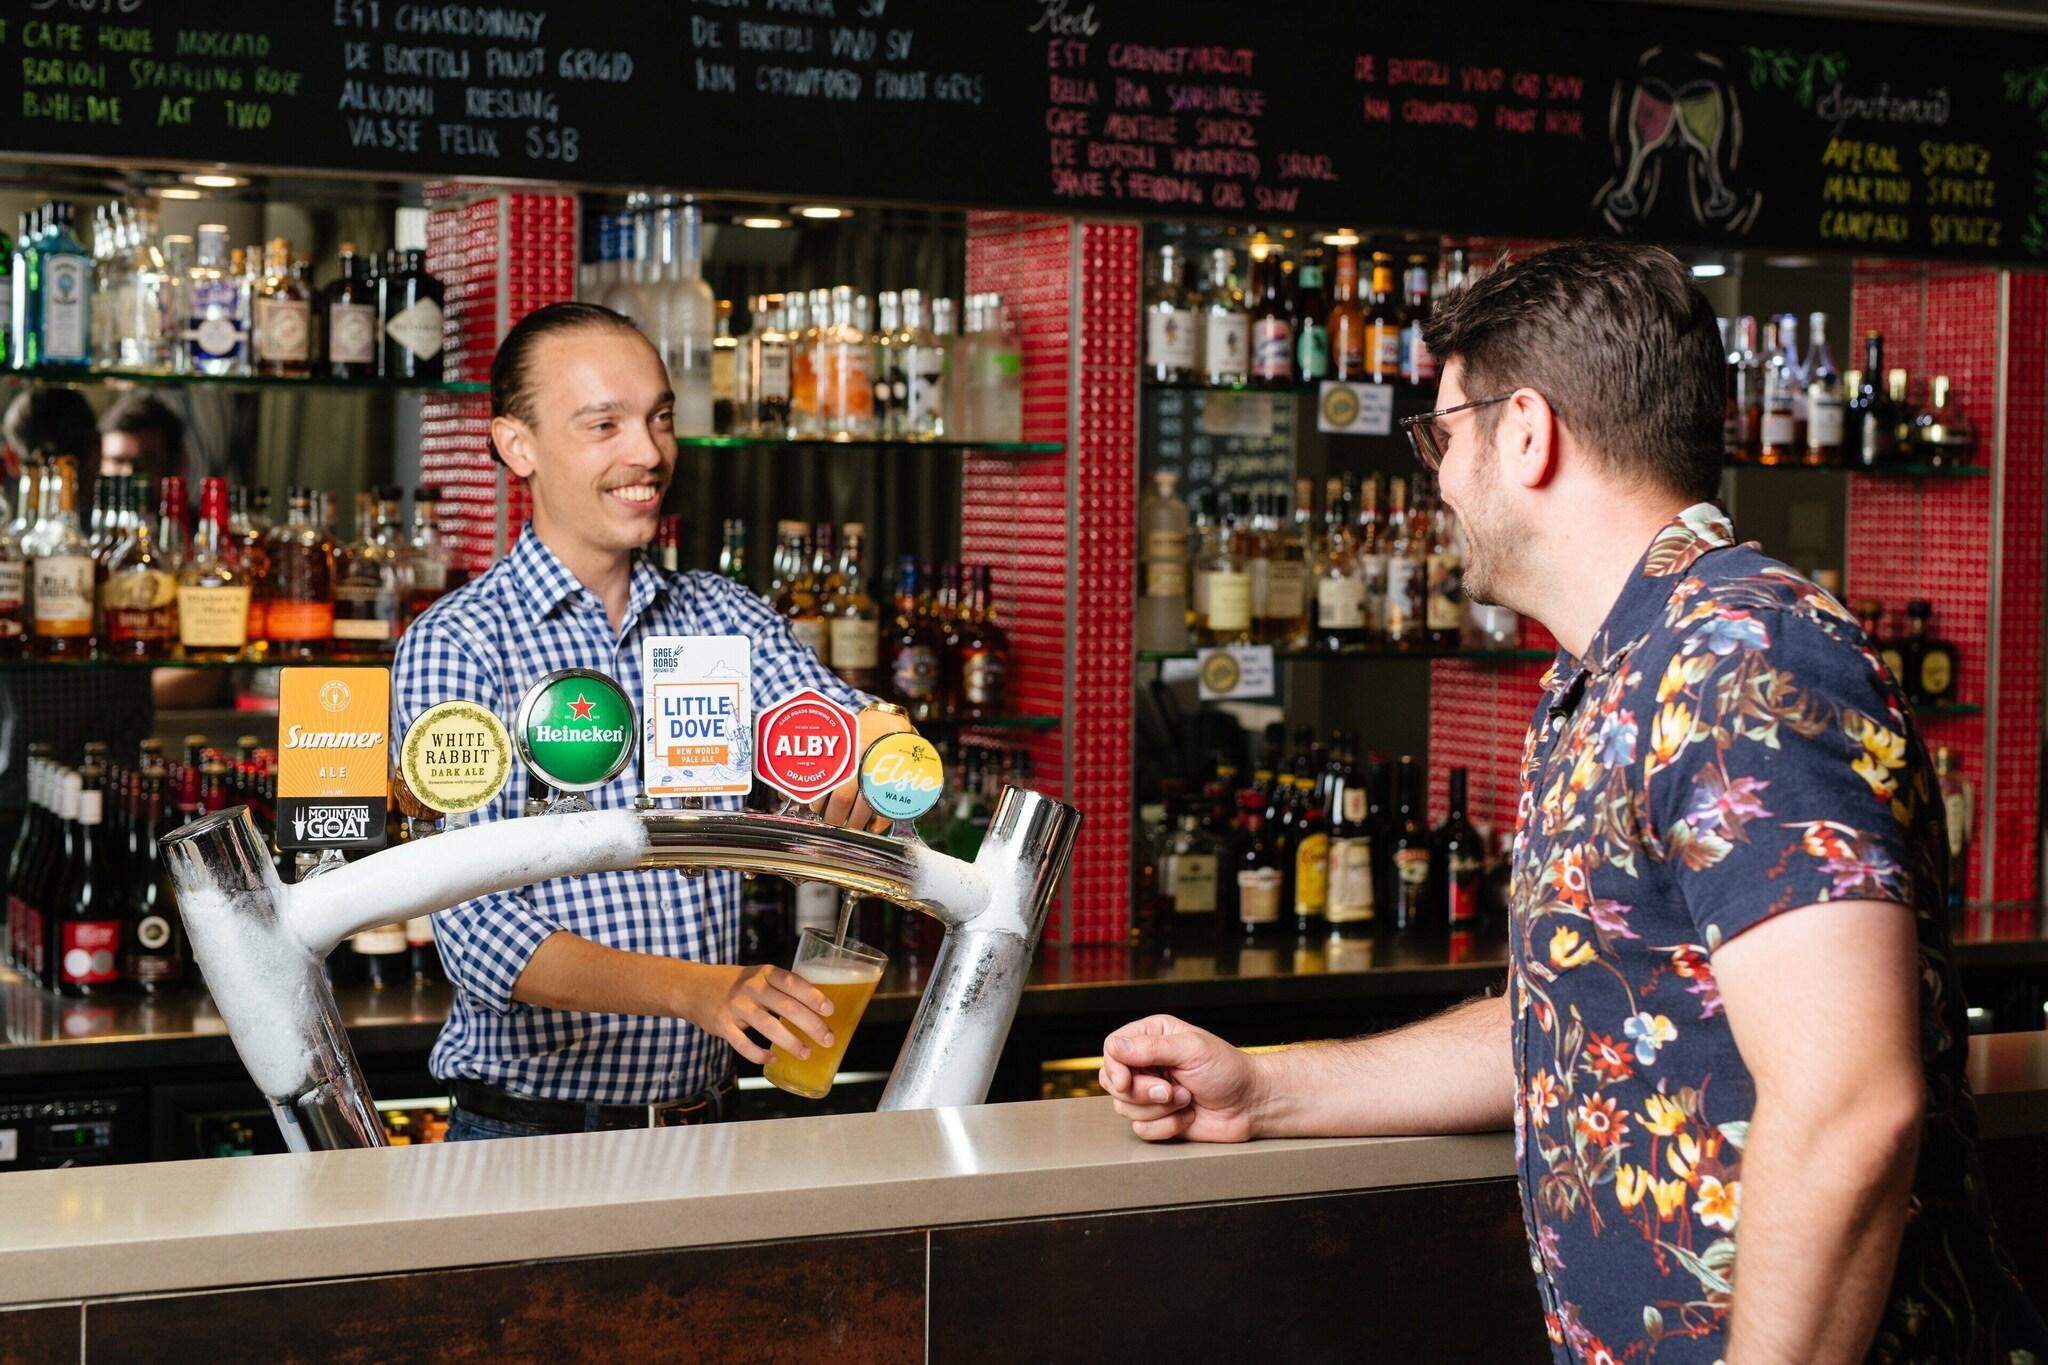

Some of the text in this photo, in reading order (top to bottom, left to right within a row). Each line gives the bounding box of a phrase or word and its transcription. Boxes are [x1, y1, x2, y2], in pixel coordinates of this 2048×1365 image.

[395, 5, 547, 41] CHARDONNAY
[1029, 0, 1099, 36] Red
[22, 20, 82, 50] CAPE
[177, 29, 271, 56] MOSCATO
[691, 16, 722, 48] DE
[344, 42, 370, 70] DE
[486, 47, 545, 79] PINOT
[225, 100, 272, 129] TWO
[348, 115, 580, 162] VASSE FELIX SSB
[653, 647, 672, 658] GAGE
[653, 658, 678, 668] ROADS
[664, 696, 731, 716] LITTLE
[284, 724, 384, 750] Summer
[536, 725, 623, 742] Heineken
[670, 718, 725, 738] DOVE
[432, 733, 485, 747] WHITE
[774, 735, 839, 757] ALBY
[426, 749, 490, 764] RABBIT
[676, 747, 692, 755] NEW
[701, 755, 715, 763] ALE
[320, 767, 347, 778] ALE
[431, 768, 485, 777] DARK ALE
[786, 769, 826, 782] DRAUGHT
[885, 791, 912, 805] WA Ale
[308, 809, 369, 820] MOUNTAIN
[307, 818, 370, 838] GOAT
